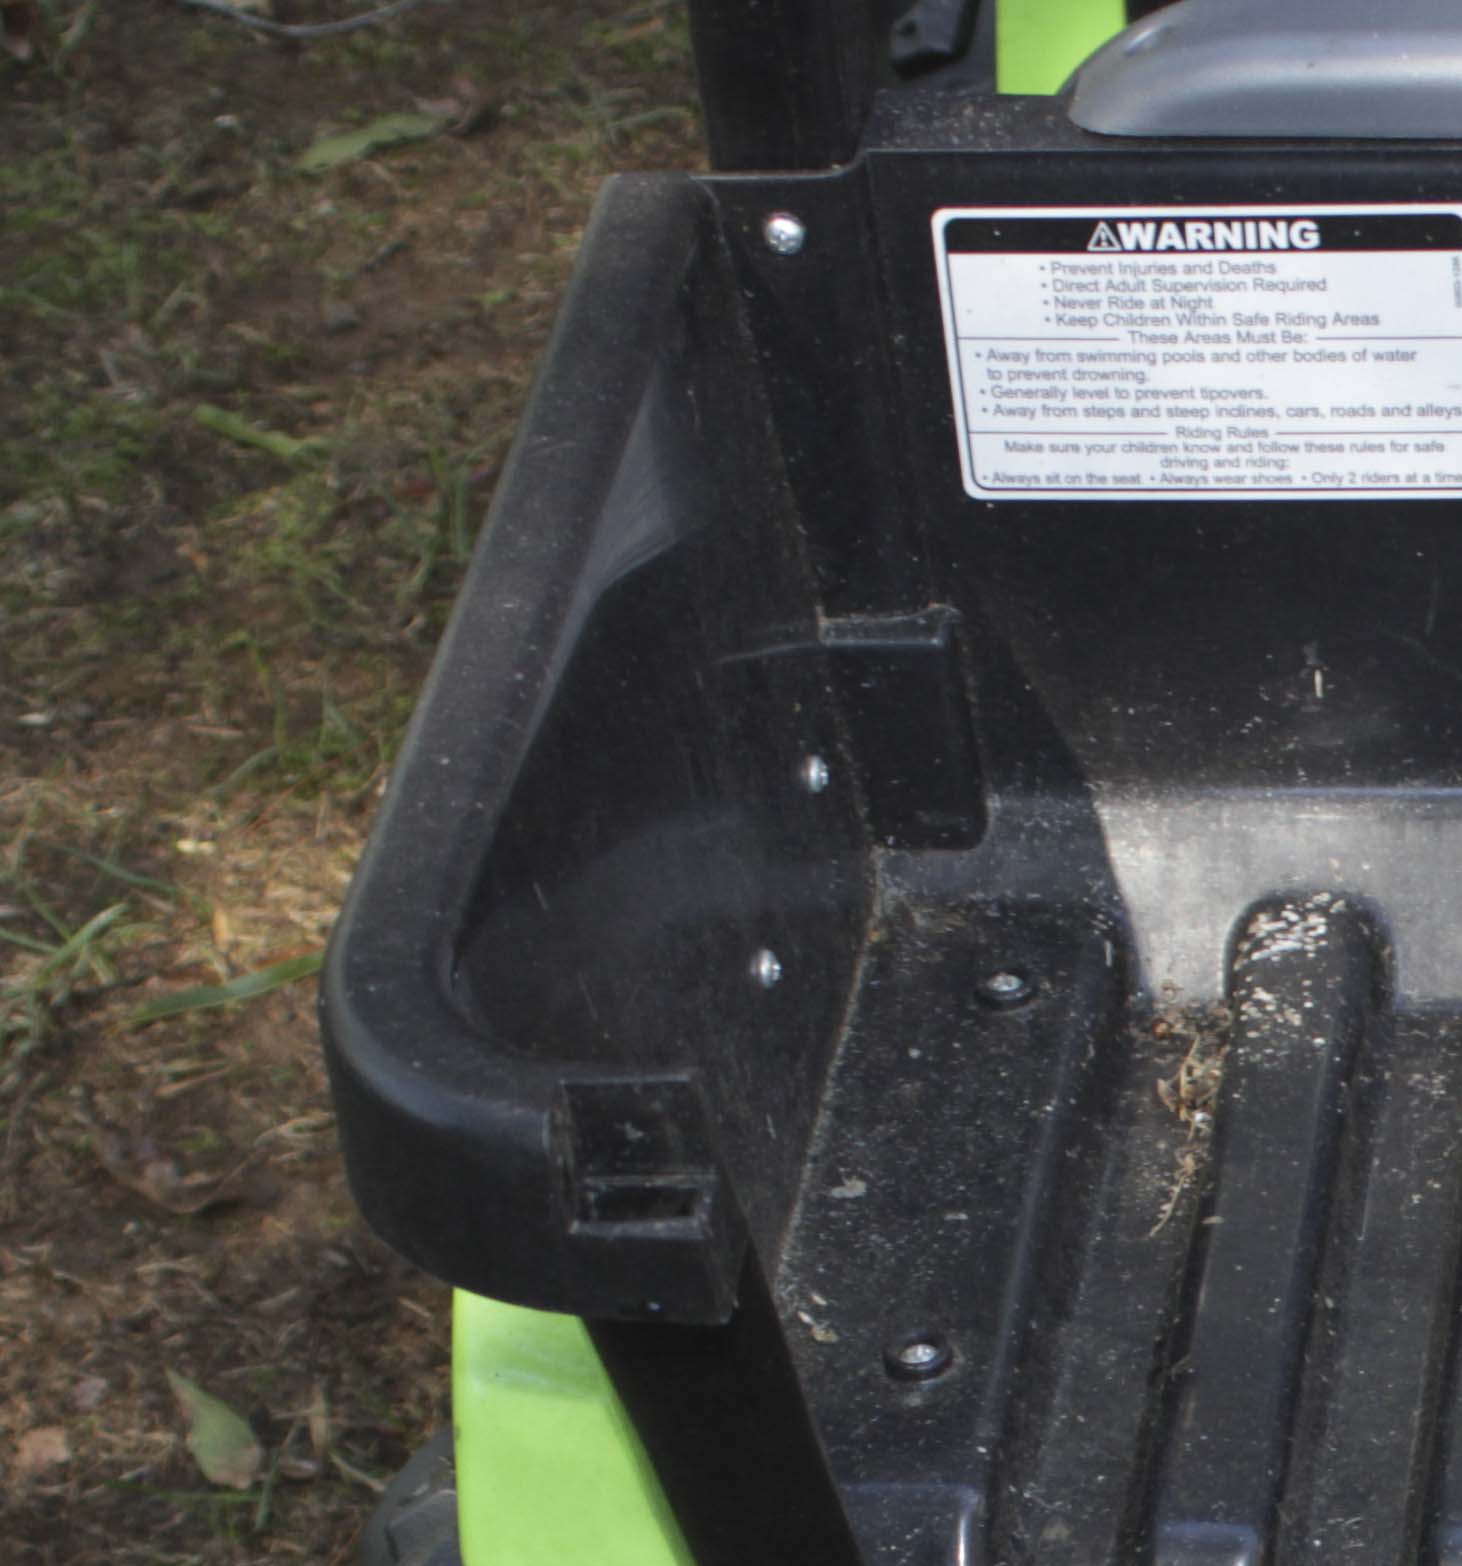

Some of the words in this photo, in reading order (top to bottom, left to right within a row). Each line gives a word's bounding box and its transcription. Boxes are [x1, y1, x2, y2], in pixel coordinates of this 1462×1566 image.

[1118, 221, 1320, 250] WARNING
[1051, 261, 1114, 275] Prevent
[1119, 262, 1178, 278] Injuries
[1182, 262, 1213, 275] and
[1218, 261, 1277, 275] Deaths
[1053, 278, 1100, 293] Direct
[1105, 278, 1147, 293] Adult
[1152, 278, 1247, 294] Supervision
[1253, 278, 1327, 294] Required
[1054, 296, 1102, 310] Never
[1108, 296, 1145, 310] Ride
[1150, 297, 1166, 309] at
[1170, 296, 1213, 313] Night
[1056, 314, 1098, 328] Keep
[1103, 313, 1171, 327] Children
[1176, 312, 1227, 326] Within
[1232, 312, 1270, 326] Safe
[1275, 312, 1327, 329] Riding
[1332, 312, 1380, 326] Areas
[1128, 330, 1178, 344] These
[1184, 331, 1231, 344] Areas
[1236, 330, 1276, 344] Must
[1281, 330, 1308, 344] Be:
[987, 348, 1030, 365] Away
[1035, 349, 1072, 362] from
[1076, 350, 1157, 366] swimming
[1162, 350, 1206, 365] pools
[1211, 350, 1241, 363] and
[1246, 350, 1288, 362] other
[1293, 349, 1347, 362] bodies
[1352, 348, 1367, 362] of
[1372, 349, 1417, 362] water
[987, 368, 1002, 382] to
[1007, 369, 1068, 382] prevent
[1072, 368, 1149, 384] drowning.
[991, 385, 1068, 402] Generally
[1072, 387, 1110, 399] level
[1114, 387, 1130, 399] to
[1135, 388, 1195, 401] prevent
[1200, 388, 1267, 402] tipovers.
[992, 404, 1036, 420] Away
[1040, 404, 1078, 417] from
[1083, 405, 1126, 419] steps
[1130, 405, 1161, 418] and
[1166, 406, 1210, 420] steep
[1286, 407, 1325, 418] cars,
[1330, 405, 1376, 418] roads
[1381, 404, 1412, 417] and
[1176, 426, 1222, 440] Riding
[1226, 426, 1269, 439] Rules
[1004, 440, 1044, 453] Make
[1048, 444, 1081, 453] sure
[1085, 444, 1116, 455] your
[1121, 442, 1178, 454] children
[1183, 439, 1222, 453] know
[1227, 443, 1253, 453] and
[1258, 442, 1300, 453] follow
[1304, 442, 1345, 453] these
[1350, 442, 1386, 453] rules
[1390, 440, 1409, 453] for
[1414, 440, 1445, 452] safe
[1160, 456, 1209, 471] driving
[1214, 456, 1240, 468] and
[1246, 456, 1290, 470] riding:
[992, 472, 1040, 485] Always
[1045, 474, 1061, 484] sit
[1064, 475, 1082, 484] on
[1086, 473, 1108, 484] the
[1112, 474, 1141, 484] seat
[1160, 473, 1209, 485] Always
[1213, 475, 1247, 484] wear
[1251, 474, 1293, 484] shoes
[1312, 472, 1344, 485] Only
[1349, 472, 1356, 484] 2
[1361, 473, 1400, 483] riders
[1405, 473, 1418, 483] at
[1422, 474, 1431, 483] a
